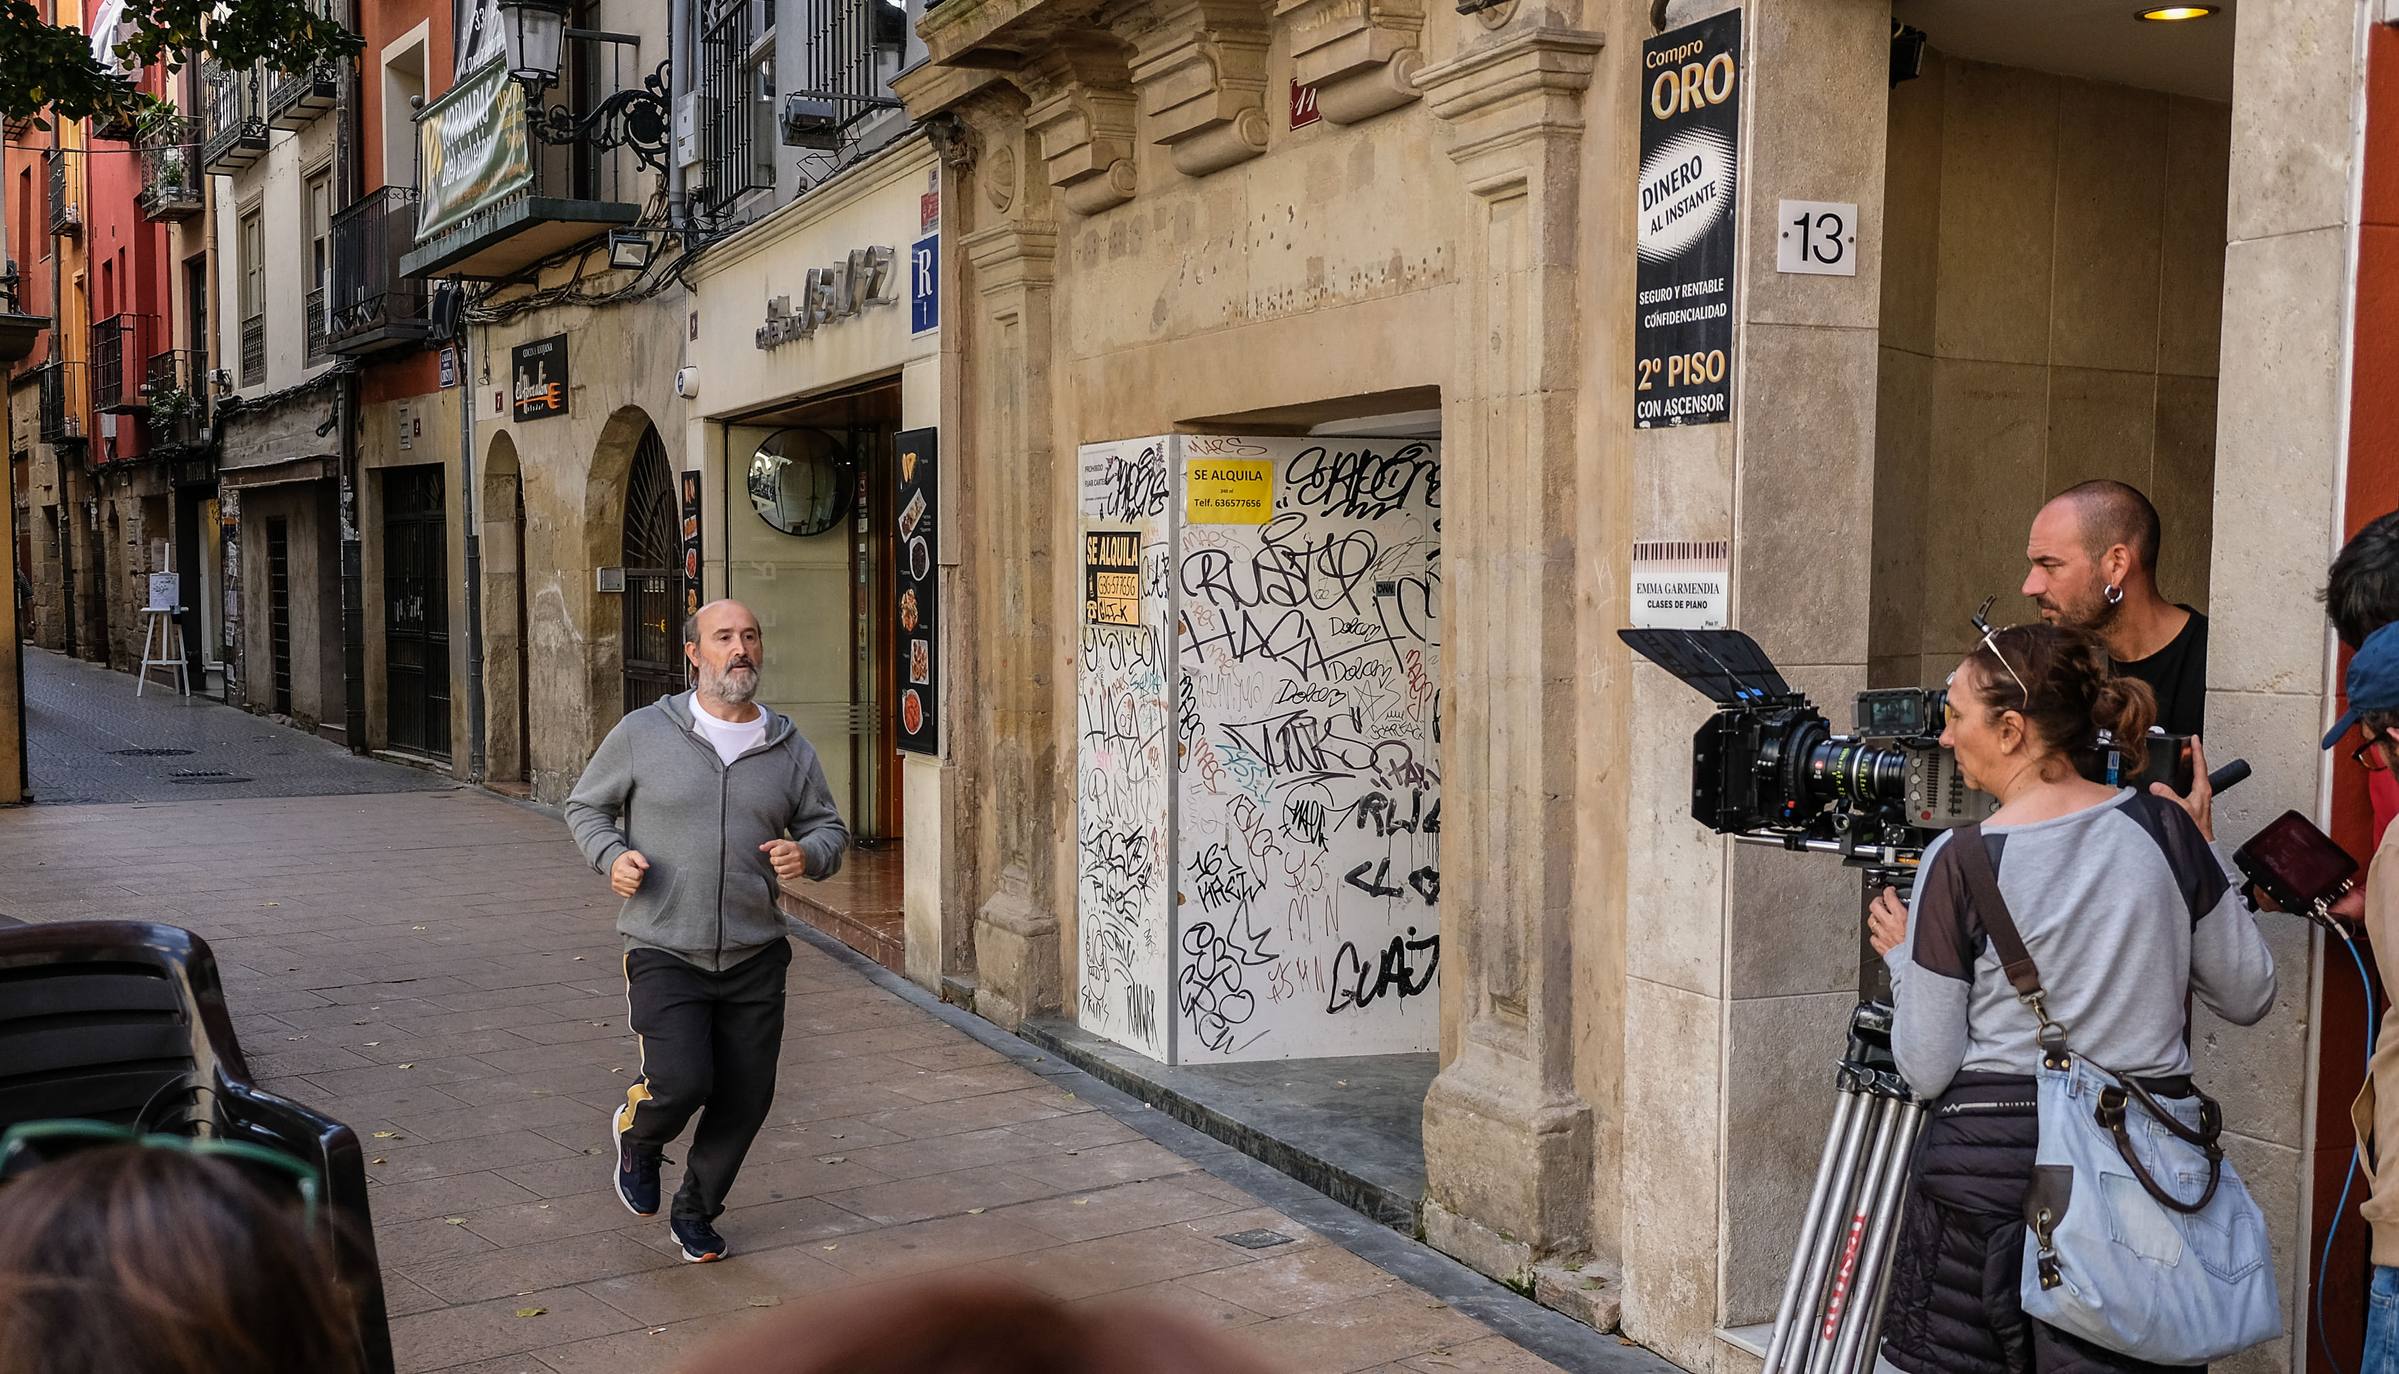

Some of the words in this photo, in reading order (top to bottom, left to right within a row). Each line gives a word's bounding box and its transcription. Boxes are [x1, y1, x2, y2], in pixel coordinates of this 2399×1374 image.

[1646, 39, 1703, 69] Compro
[1652, 53, 1735, 120] ORO
[443, 79, 492, 150] JORNADAS
[1642, 154, 1702, 212] DINERO
[1650, 215, 1664, 236] AL
[1665, 180, 1717, 226] INSTANTE
[1794, 211, 1844, 265] 13
[917, 248, 933, 299] R
[1639, 287, 1672, 305] SEGURO
[1674, 285, 1681, 300] Y
[1682, 278, 1725, 298] RENTABLE
[1644, 303, 1727, 328] CONFIDENCIALIDAD
[1638, 357, 1662, 391] 2º
[1668, 350, 1726, 388] PISO
[1637, 400, 1661, 418] CON
[1663, 393, 1725, 417] ASCENSOR
[1194, 469, 1208, 481] SE
[1211, 469, 1264, 482] ALQUILA
[1194, 498, 1213, 508] Telf.
[1215, 498, 1262, 508] 636577656
[1087, 535, 1098, 566] SE
[1099, 536, 1139, 569] ALQUILA
[1636, 582, 1663, 595] EMMA
[1664, 582, 1720, 595] GARMENDIA
[1647, 600, 1673, 609] CLASES
[1674, 600, 1683, 609] DE
[1685, 600, 1708, 609] PIANO
